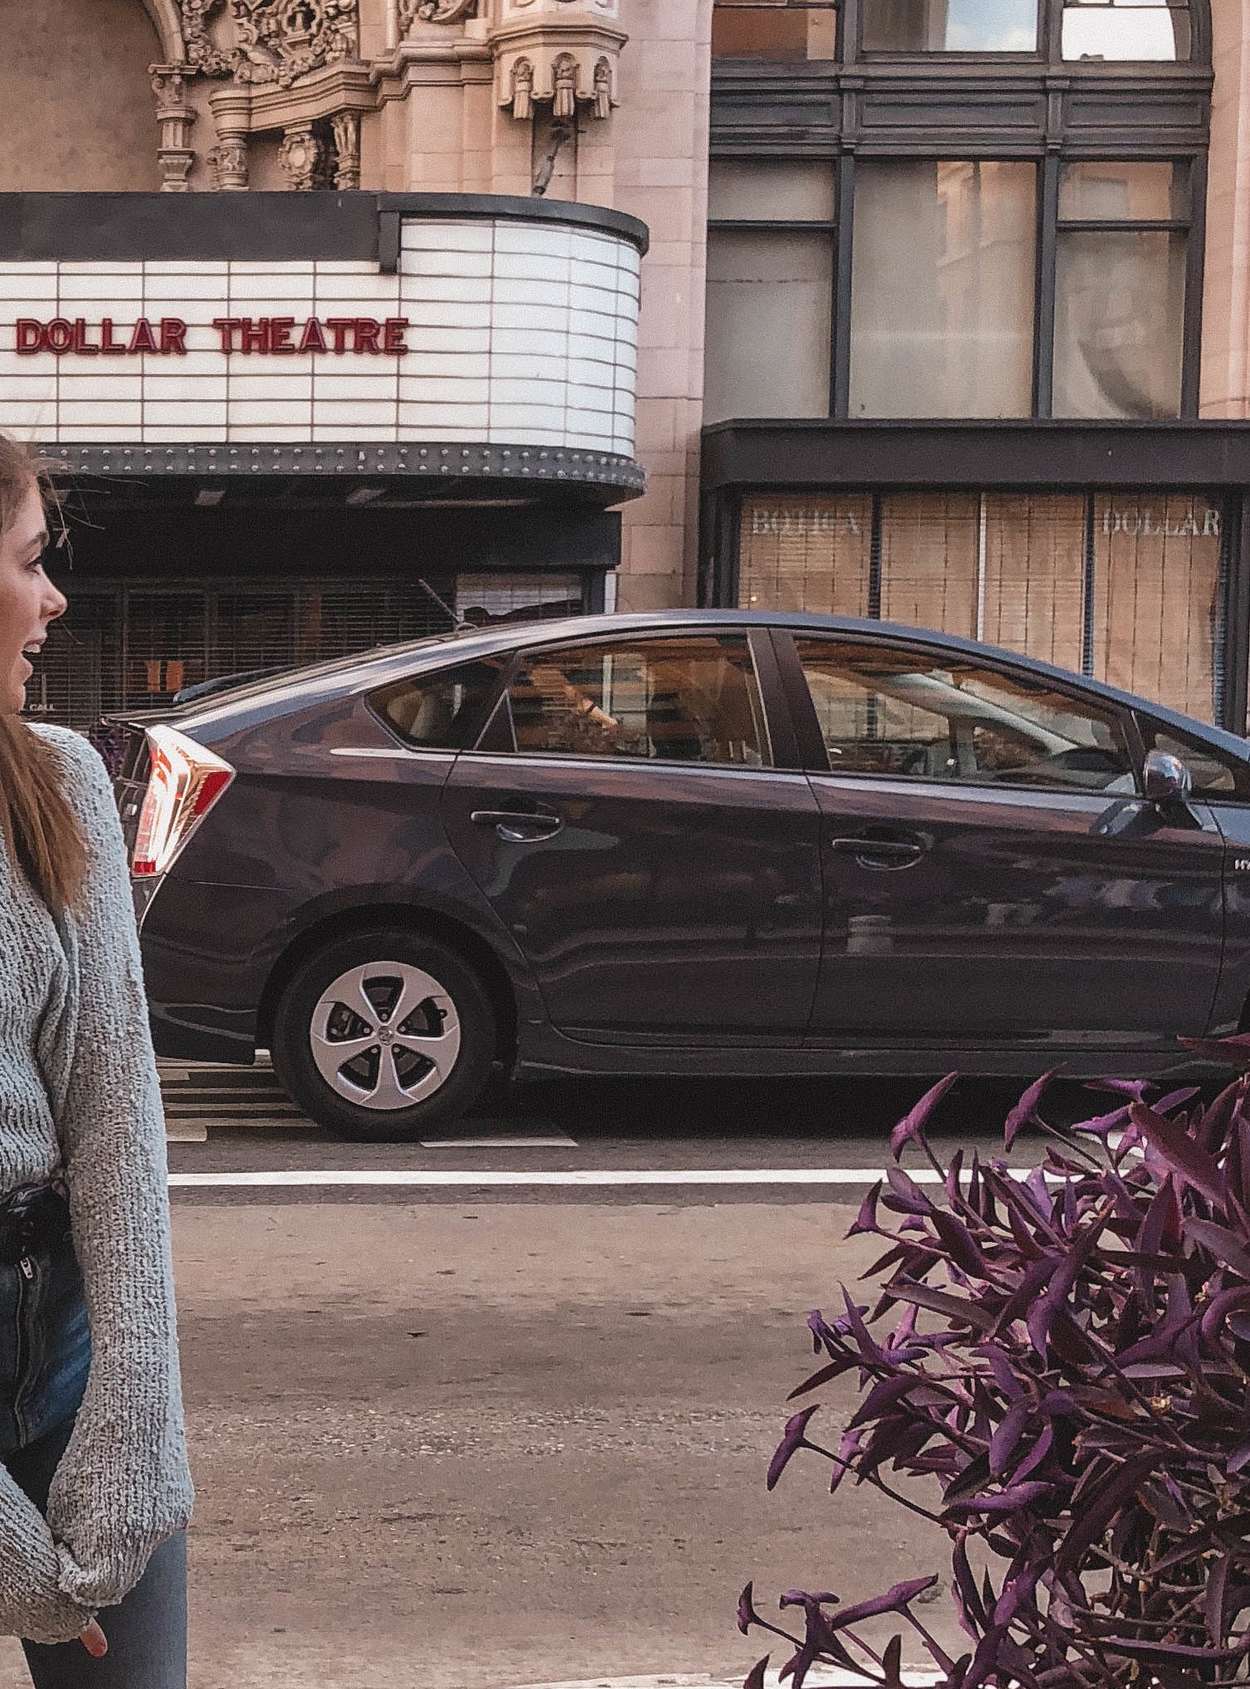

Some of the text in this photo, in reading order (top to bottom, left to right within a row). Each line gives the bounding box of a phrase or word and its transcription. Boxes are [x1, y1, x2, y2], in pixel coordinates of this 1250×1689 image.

[16, 317, 188, 355] DOLLAR
[213, 317, 410, 355] THEATRE
[1102, 508, 1220, 536] DOLLAR
